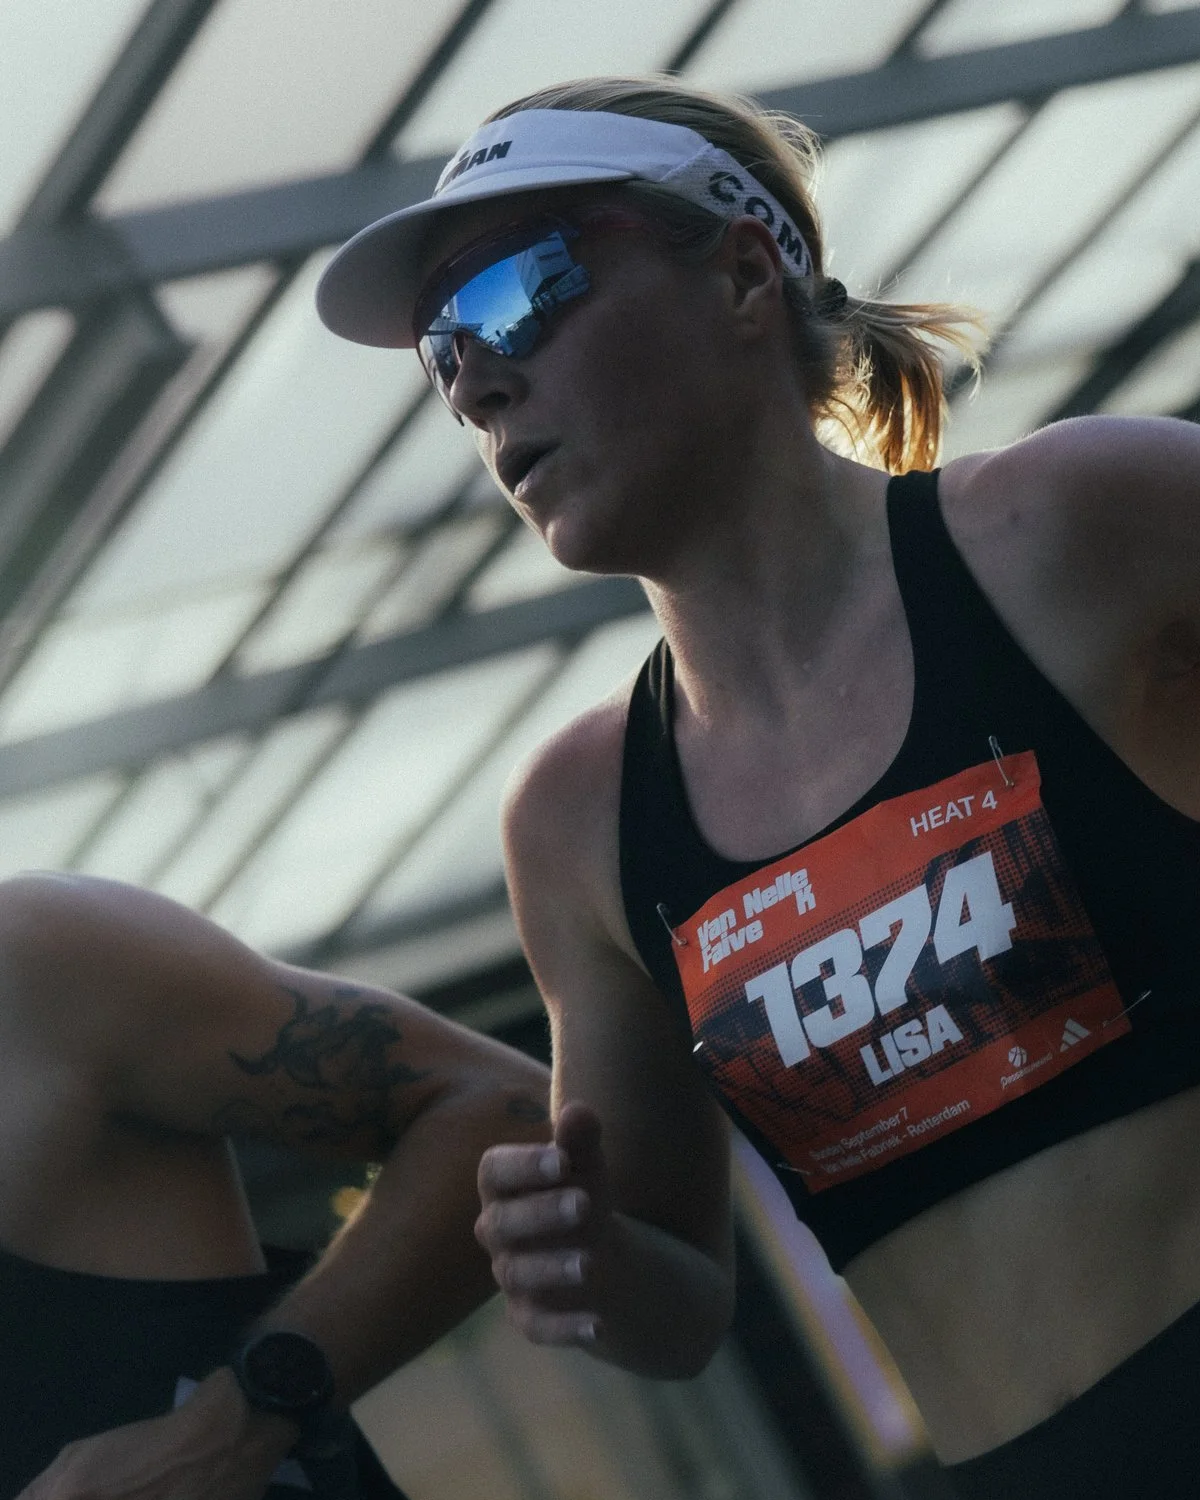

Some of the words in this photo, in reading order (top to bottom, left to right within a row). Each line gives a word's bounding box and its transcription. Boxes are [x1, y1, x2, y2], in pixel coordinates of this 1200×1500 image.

[910, 795, 975, 837] HEAT
[981, 790, 998, 810] 4
[696, 908, 737, 949] Van
[742, 868, 809, 919] Nelle
[795, 883, 817, 916] K
[744, 851, 1017, 1069] 1374
[859, 1004, 964, 1086] LISA
[840, 1113, 902, 1149] September
[898, 1106, 909, 1121] 7
[906, 1099, 971, 1137] Rotterdam
